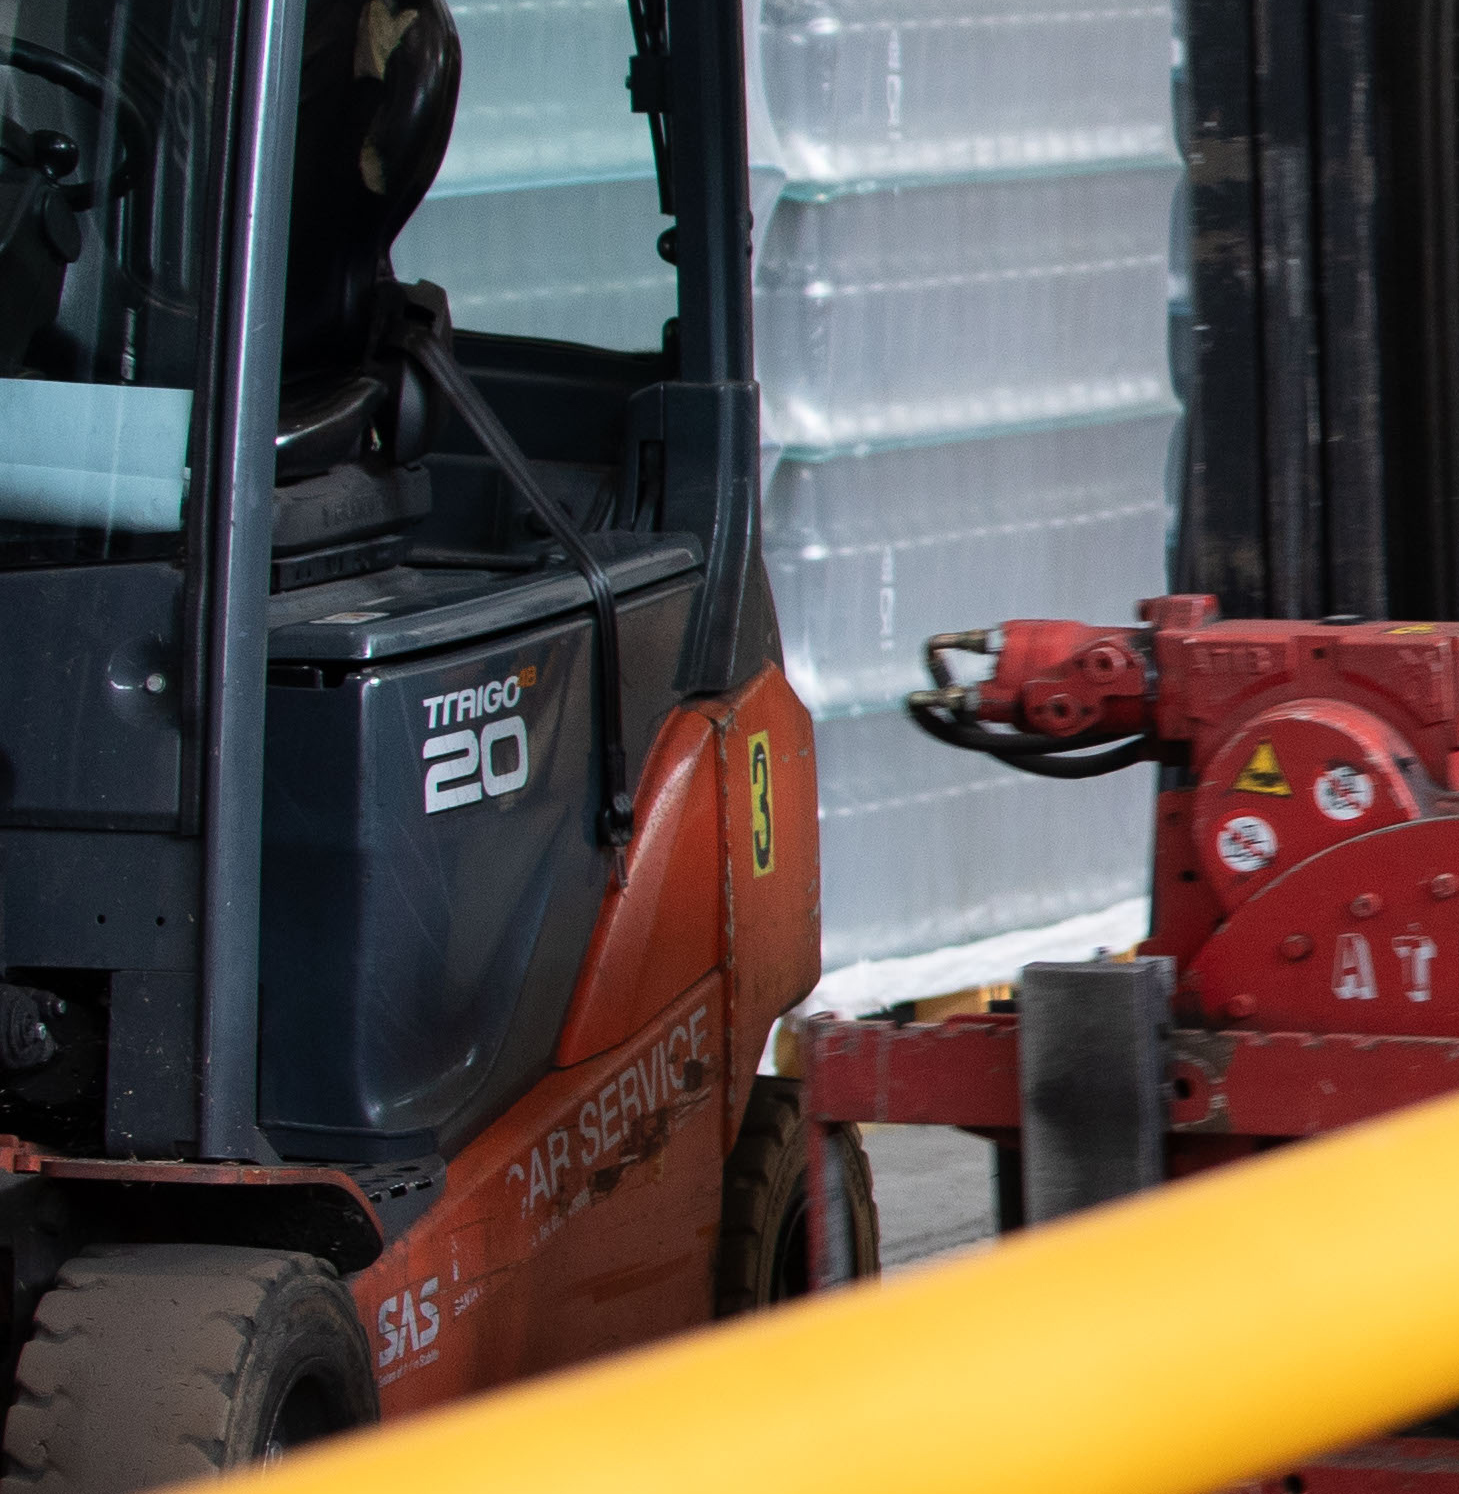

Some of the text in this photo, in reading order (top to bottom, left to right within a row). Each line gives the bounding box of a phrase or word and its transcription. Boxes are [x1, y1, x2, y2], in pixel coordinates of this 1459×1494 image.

[423, 715, 529, 814] 20
[752, 741, 771, 869] 3
[579, 1005, 709, 1167] SERVICE
[378, 1276, 440, 1367] SAS
